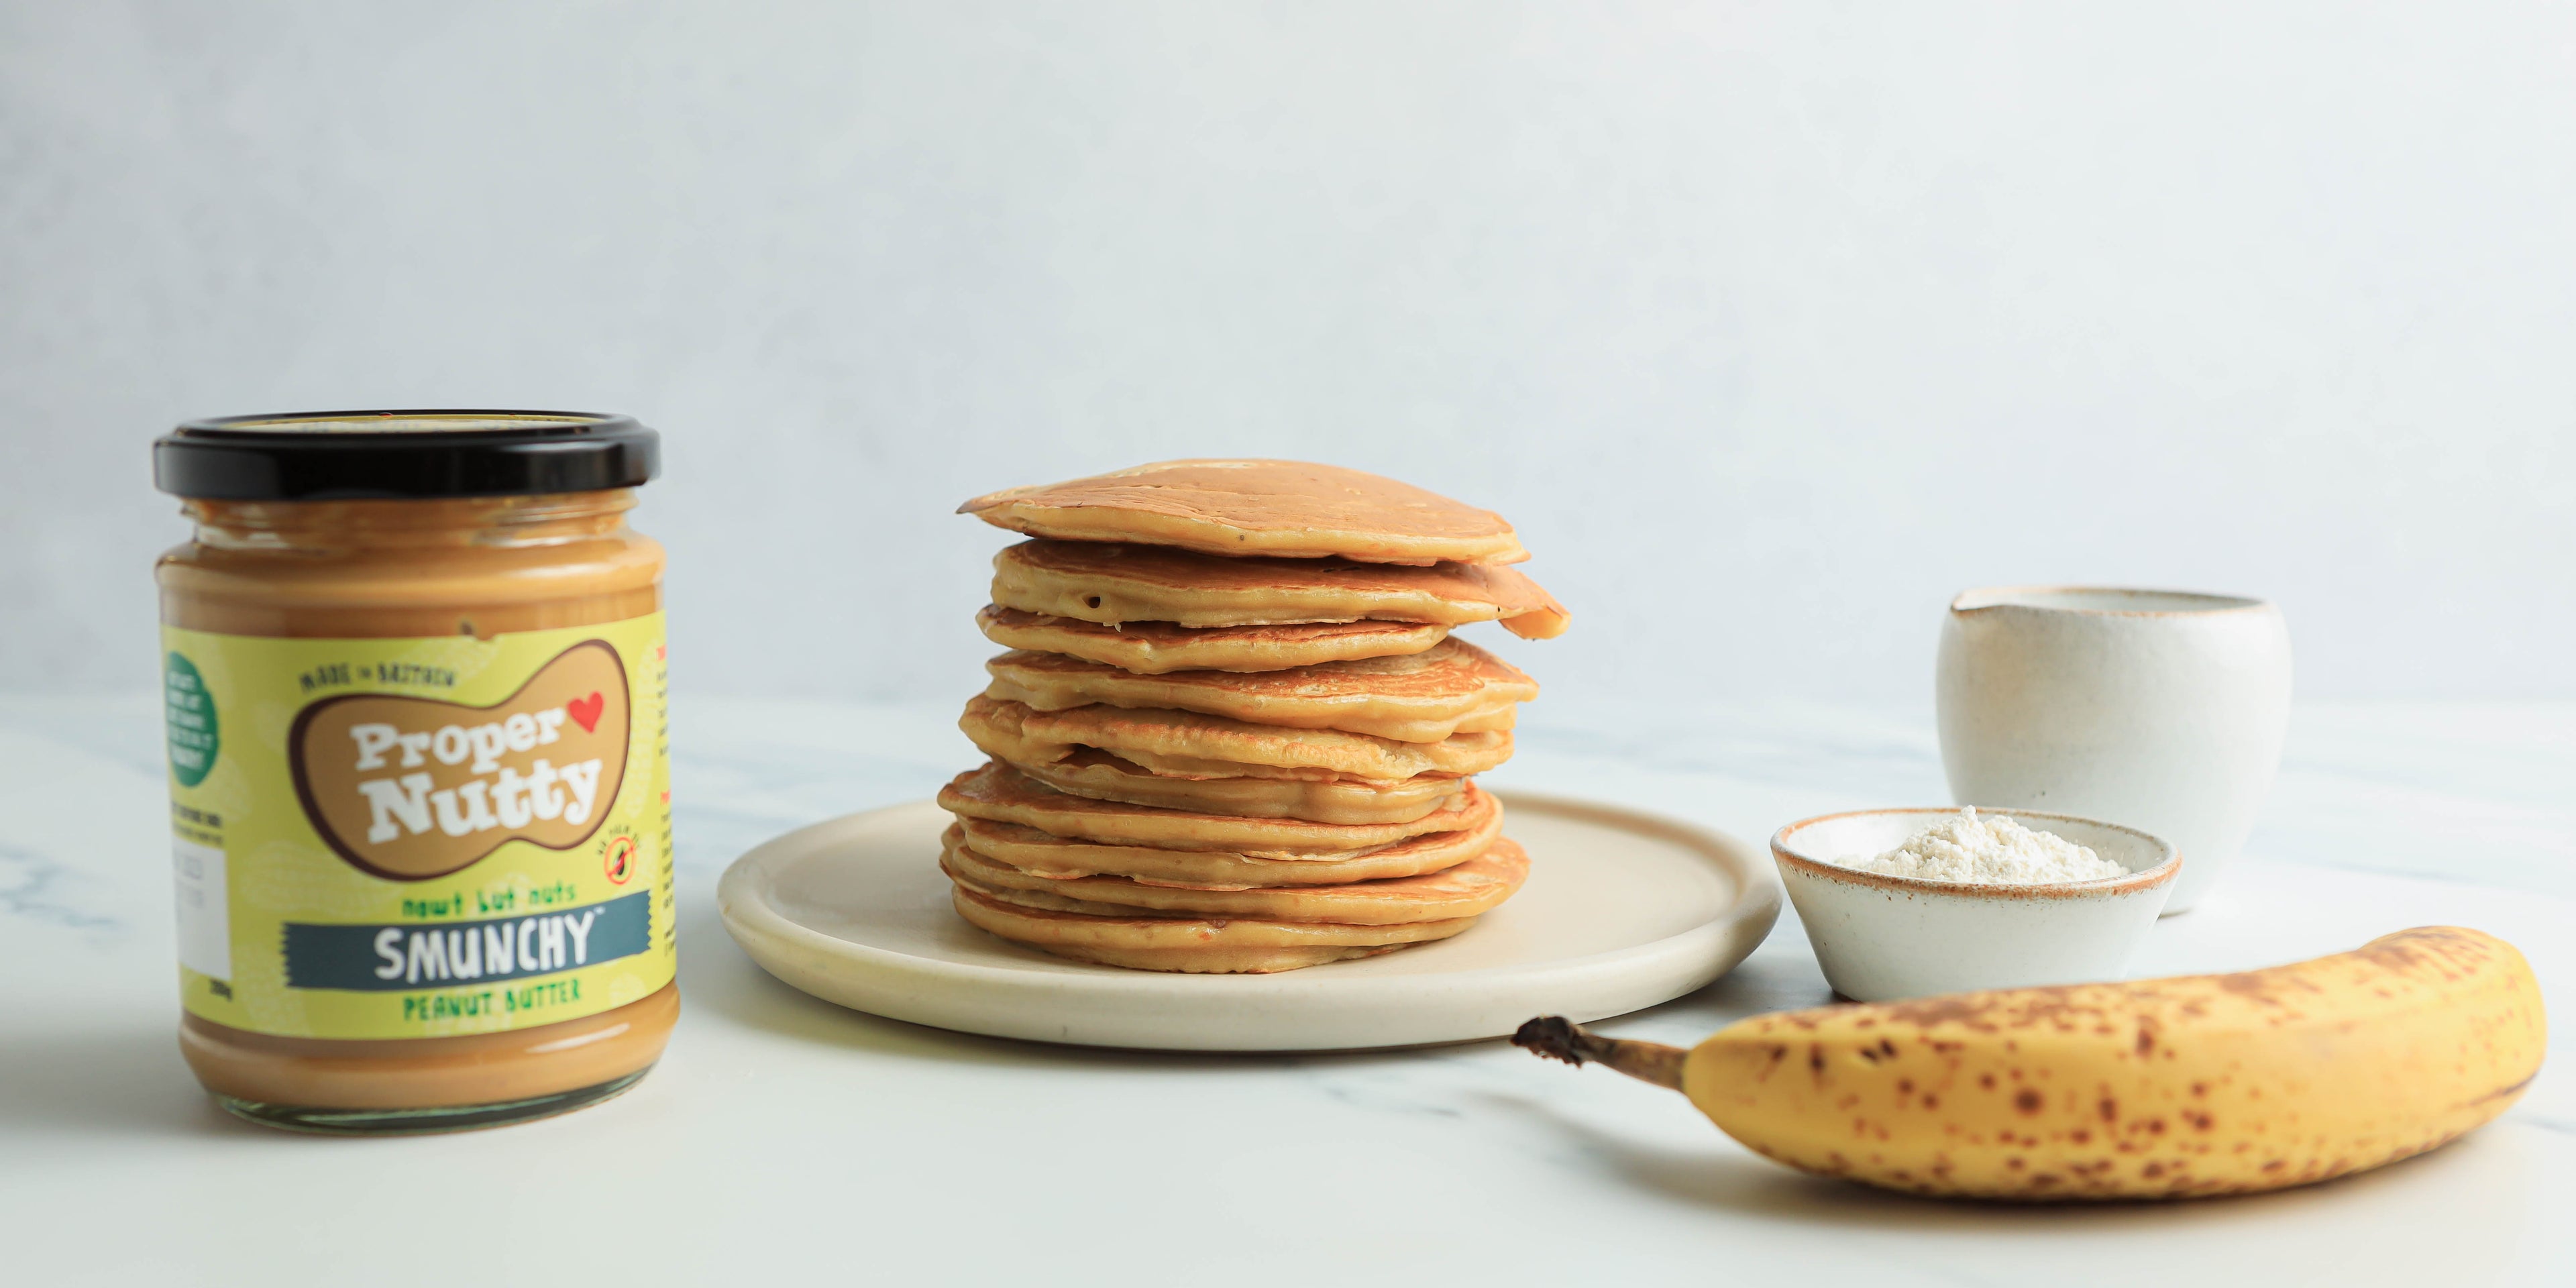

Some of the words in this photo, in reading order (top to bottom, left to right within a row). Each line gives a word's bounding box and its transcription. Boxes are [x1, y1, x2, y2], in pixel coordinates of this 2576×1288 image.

[350, 706, 566, 774] Proper
[358, 758, 603, 845] Nutty
[402, 892, 462, 918] nowt
[478, 889, 515, 912] but
[529, 881, 576, 906] nuts
[403, 991, 493, 1022] PEANUT
[506, 979, 582, 1012] BUTTER
